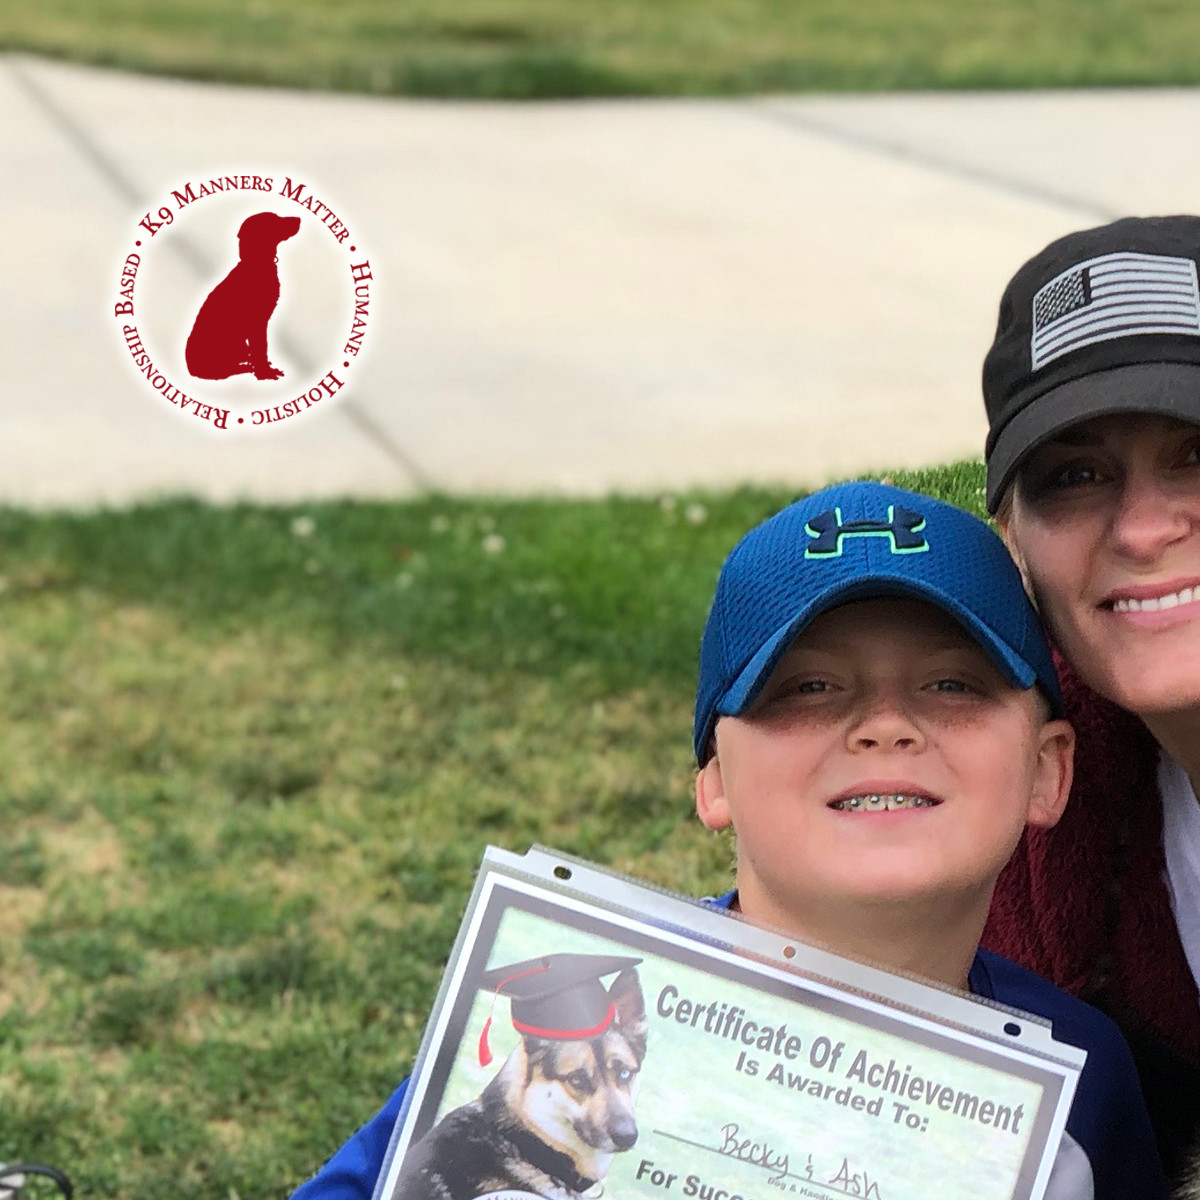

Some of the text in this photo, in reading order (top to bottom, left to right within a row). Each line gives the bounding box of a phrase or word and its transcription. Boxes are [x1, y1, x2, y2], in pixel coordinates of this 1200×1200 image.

[656, 984, 1024, 1134] Certificate Of Achievement
[735, 1051, 929, 1132] Is Awarded To:
[635, 1159, 677, 1189] For
[719, 1123, 788, 1179] Becky
[767, 1176, 786, 1190] Dog
[789, 1183, 796, 1192] &
